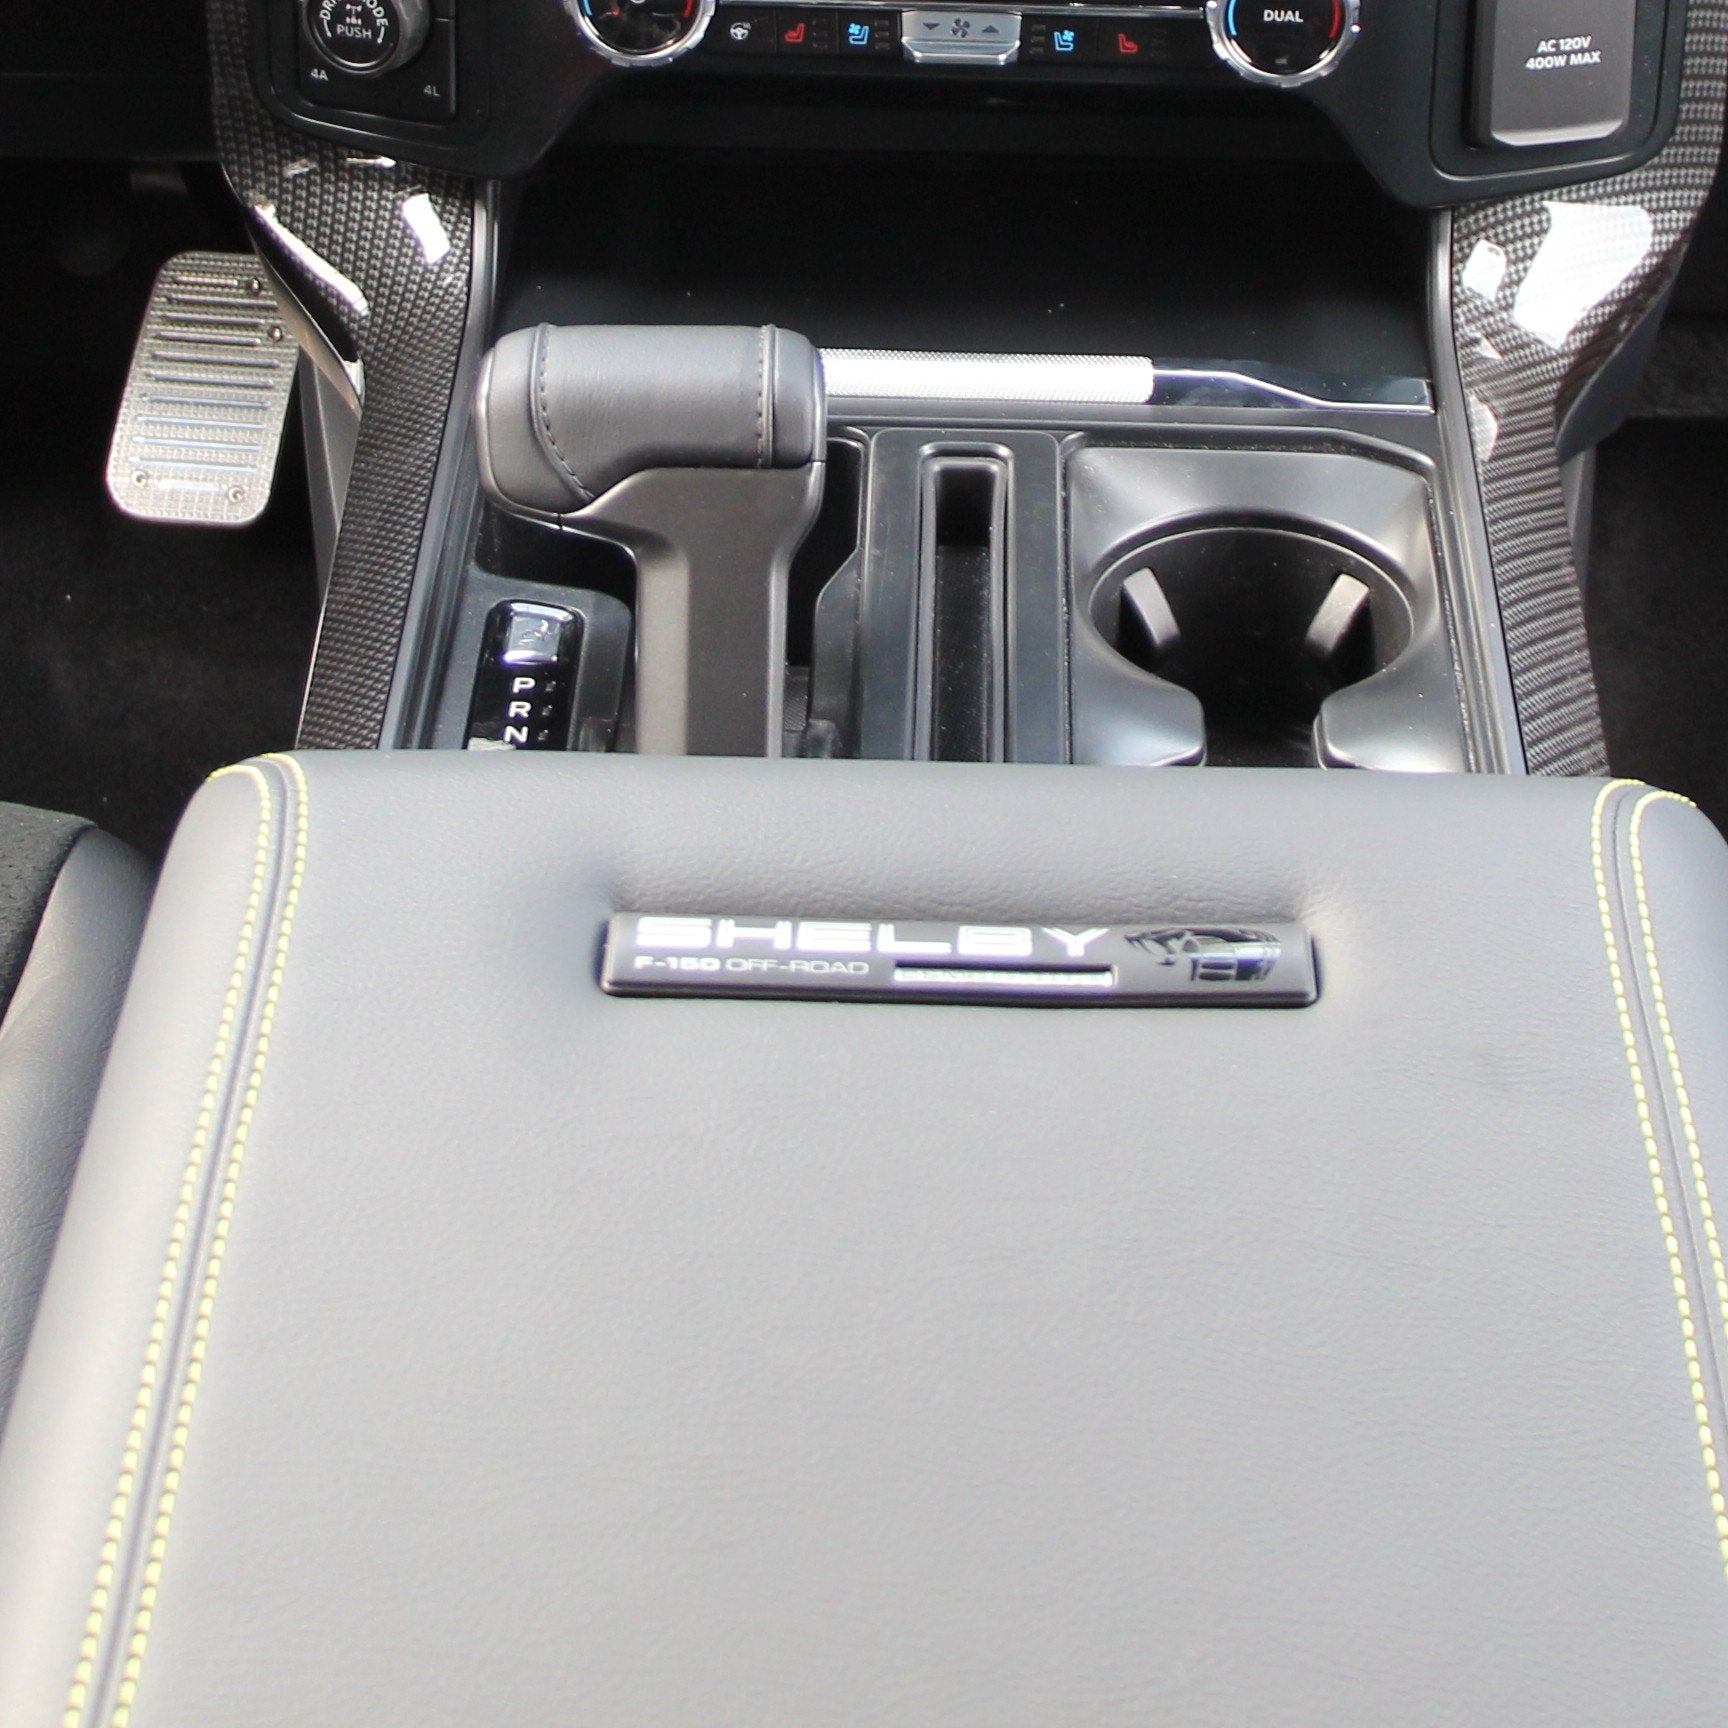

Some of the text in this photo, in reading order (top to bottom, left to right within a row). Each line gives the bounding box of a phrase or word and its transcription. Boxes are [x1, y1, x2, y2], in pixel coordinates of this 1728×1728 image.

[1263, 9, 1303, 23] DUAL
[336, 23, 372, 39] PUSH
[1537, 35, 1592, 52] AC 120V
[1525, 49, 1602, 70] 400W MAX
[310, 68, 328, 81] 4A
[424, 84, 440, 97] 4L
[512, 677, 536, 694] P
[508, 701, 532, 718] R
[504, 725, 529, 743] N
[635, 916, 1111, 957] SHELBY
[635, 955, 870, 975] F-150 OFF-ROAD
